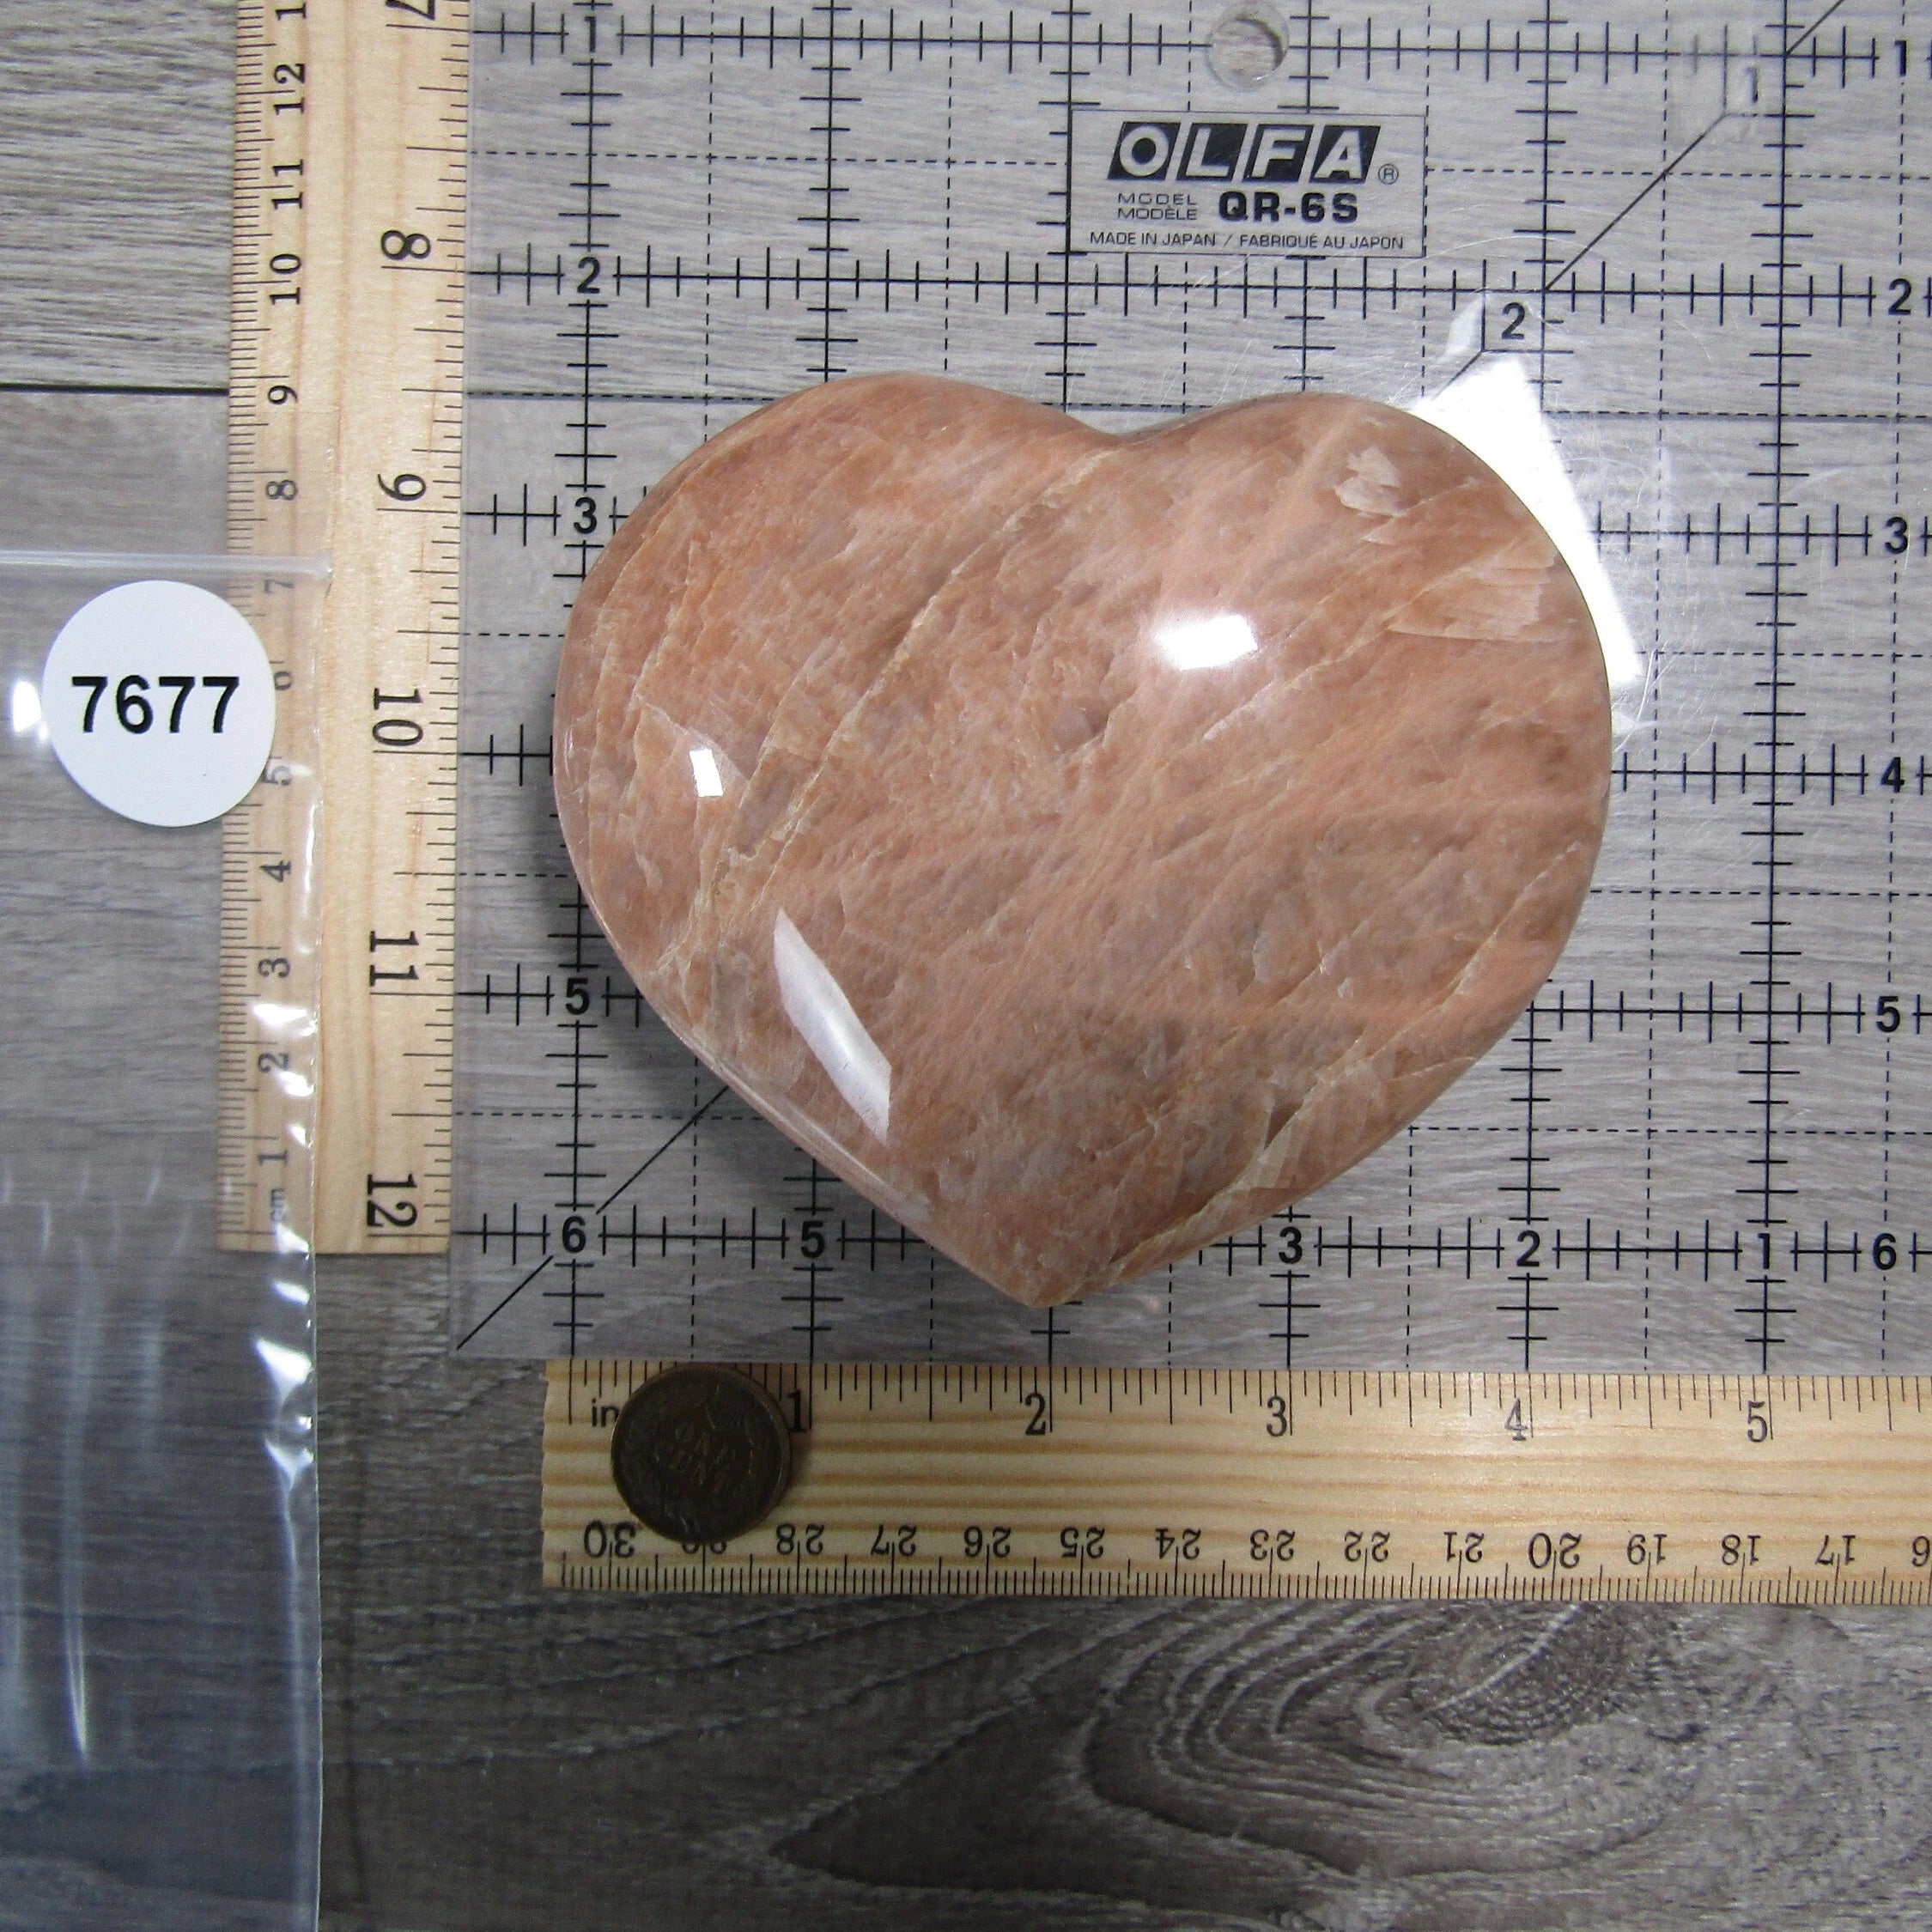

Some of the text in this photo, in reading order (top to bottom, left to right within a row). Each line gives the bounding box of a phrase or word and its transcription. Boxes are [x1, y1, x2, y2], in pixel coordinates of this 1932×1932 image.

[386, 0, 436, 21] 7
[584, 15, 597, 53] 1
[1893, 39, 1908, 76] 1
[273, 63, 307, 116] 12
[1112, 123, 1375, 181] OLFA
[271, 158, 304, 210] 11
[1118, 191, 1358, 223] MODEL QR-6S
[380, 229, 431, 260] 8
[1090, 231, 1136, 246] MADE
[1141, 232, 1157, 246] IN
[1162, 232, 1216, 246] JAPAN
[1240, 234, 1318, 249] FABRIQUÉ
[1323, 236, 1345, 249] AU
[1350, 236, 1404, 250] JAPON
[269, 253, 301, 306] 10
[577, 257, 601, 294] 2
[1888, 278, 1913, 316] 2
[1500, 302, 1525, 339] 2
[267, 384, 299, 404] 9
[265, 479, 299, 501] 8
[378, 473, 427, 501] 9
[574, 496, 598, 534] 3
[1884, 517, 1909, 555] 3
[264, 579, 295, 594] 7
[71, 674, 240, 734] 7677
[372, 687, 424, 747] 10
[1880, 756, 1905, 793] 4
[259, 860, 292, 883] 4
[258, 957, 291, 979] 3
[369, 930, 420, 987] 11
[565, 977, 590, 1016] 5
[1875, 995, 1901, 1034] 5
[258, 1052, 290, 1072] 2
[258, 1150, 289, 1166] 1
[367, 1173, 418, 1227] 12
[561, 1215, 586, 1254] 6
[800, 1220, 825, 1259] 5
[1278, 1226, 1303, 1264] 3
[1516, 1230, 1540, 1267] 2
[1757, 1232, 1771, 1270] 1
[1872, 1232, 1898, 1270] 6
[787, 1389, 807, 1433] 1
[1025, 1392, 1047, 1436] 2
[1267, 1395, 1287, 1437] 3
[1504, 1398, 1528, 1442] 4
[1747, 1400, 1769, 1443] 5
[584, 1520, 636, 1558] 30
[775, 1523, 825, 1556] 28
[870, 1524, 918, 1557] 27
[963, 1526, 1012, 1558] 26
[1060, 1526, 1105, 1559] 25
[1155, 1528, 1201, 1560] 24
[1249, 1529, 1296, 1561] 23
[1344, 1530, 1391, 1563] 22
[1443, 1531, 1485, 1564] 21
[1528, 1532, 1583, 1570] 20
[1626, 1534, 1668, 1565] 19
[1721, 1534, 1762, 1566] 18
[1814, 1534, 1856, 1566] 17
